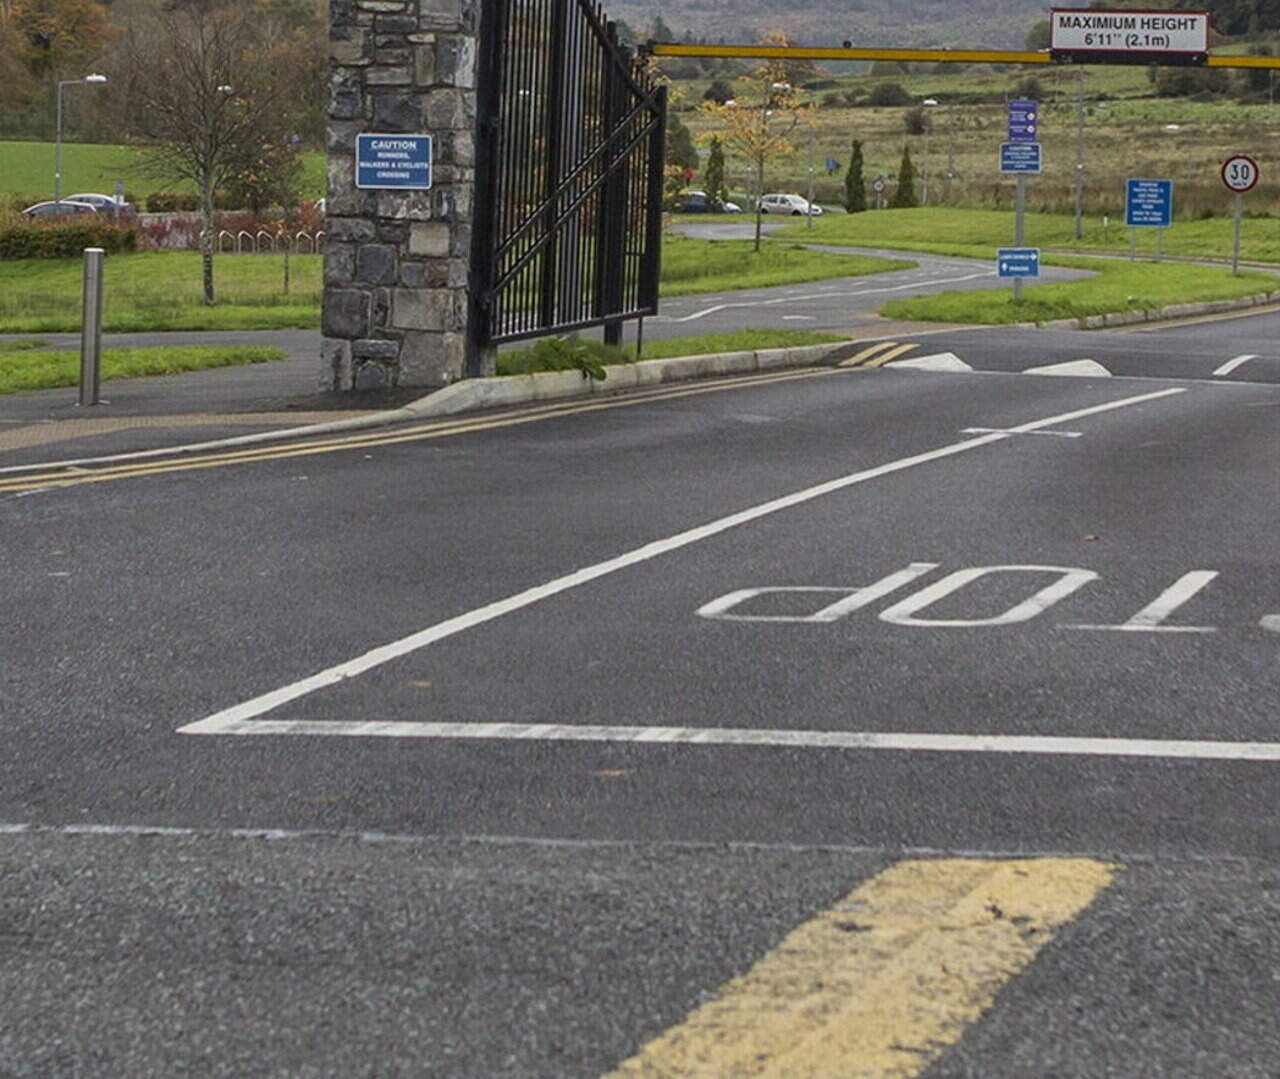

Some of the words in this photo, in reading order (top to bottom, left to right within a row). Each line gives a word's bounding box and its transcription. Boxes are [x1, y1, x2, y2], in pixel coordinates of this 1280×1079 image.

[1059, 16, 1136, 29] MAXIMIUM
[1140, 17, 1197, 30] HEIGHT
[1125, 34, 1170, 48] (2.1m)
[370, 140, 417, 150] CAUTION
[1230, 164, 1250, 180] 30
